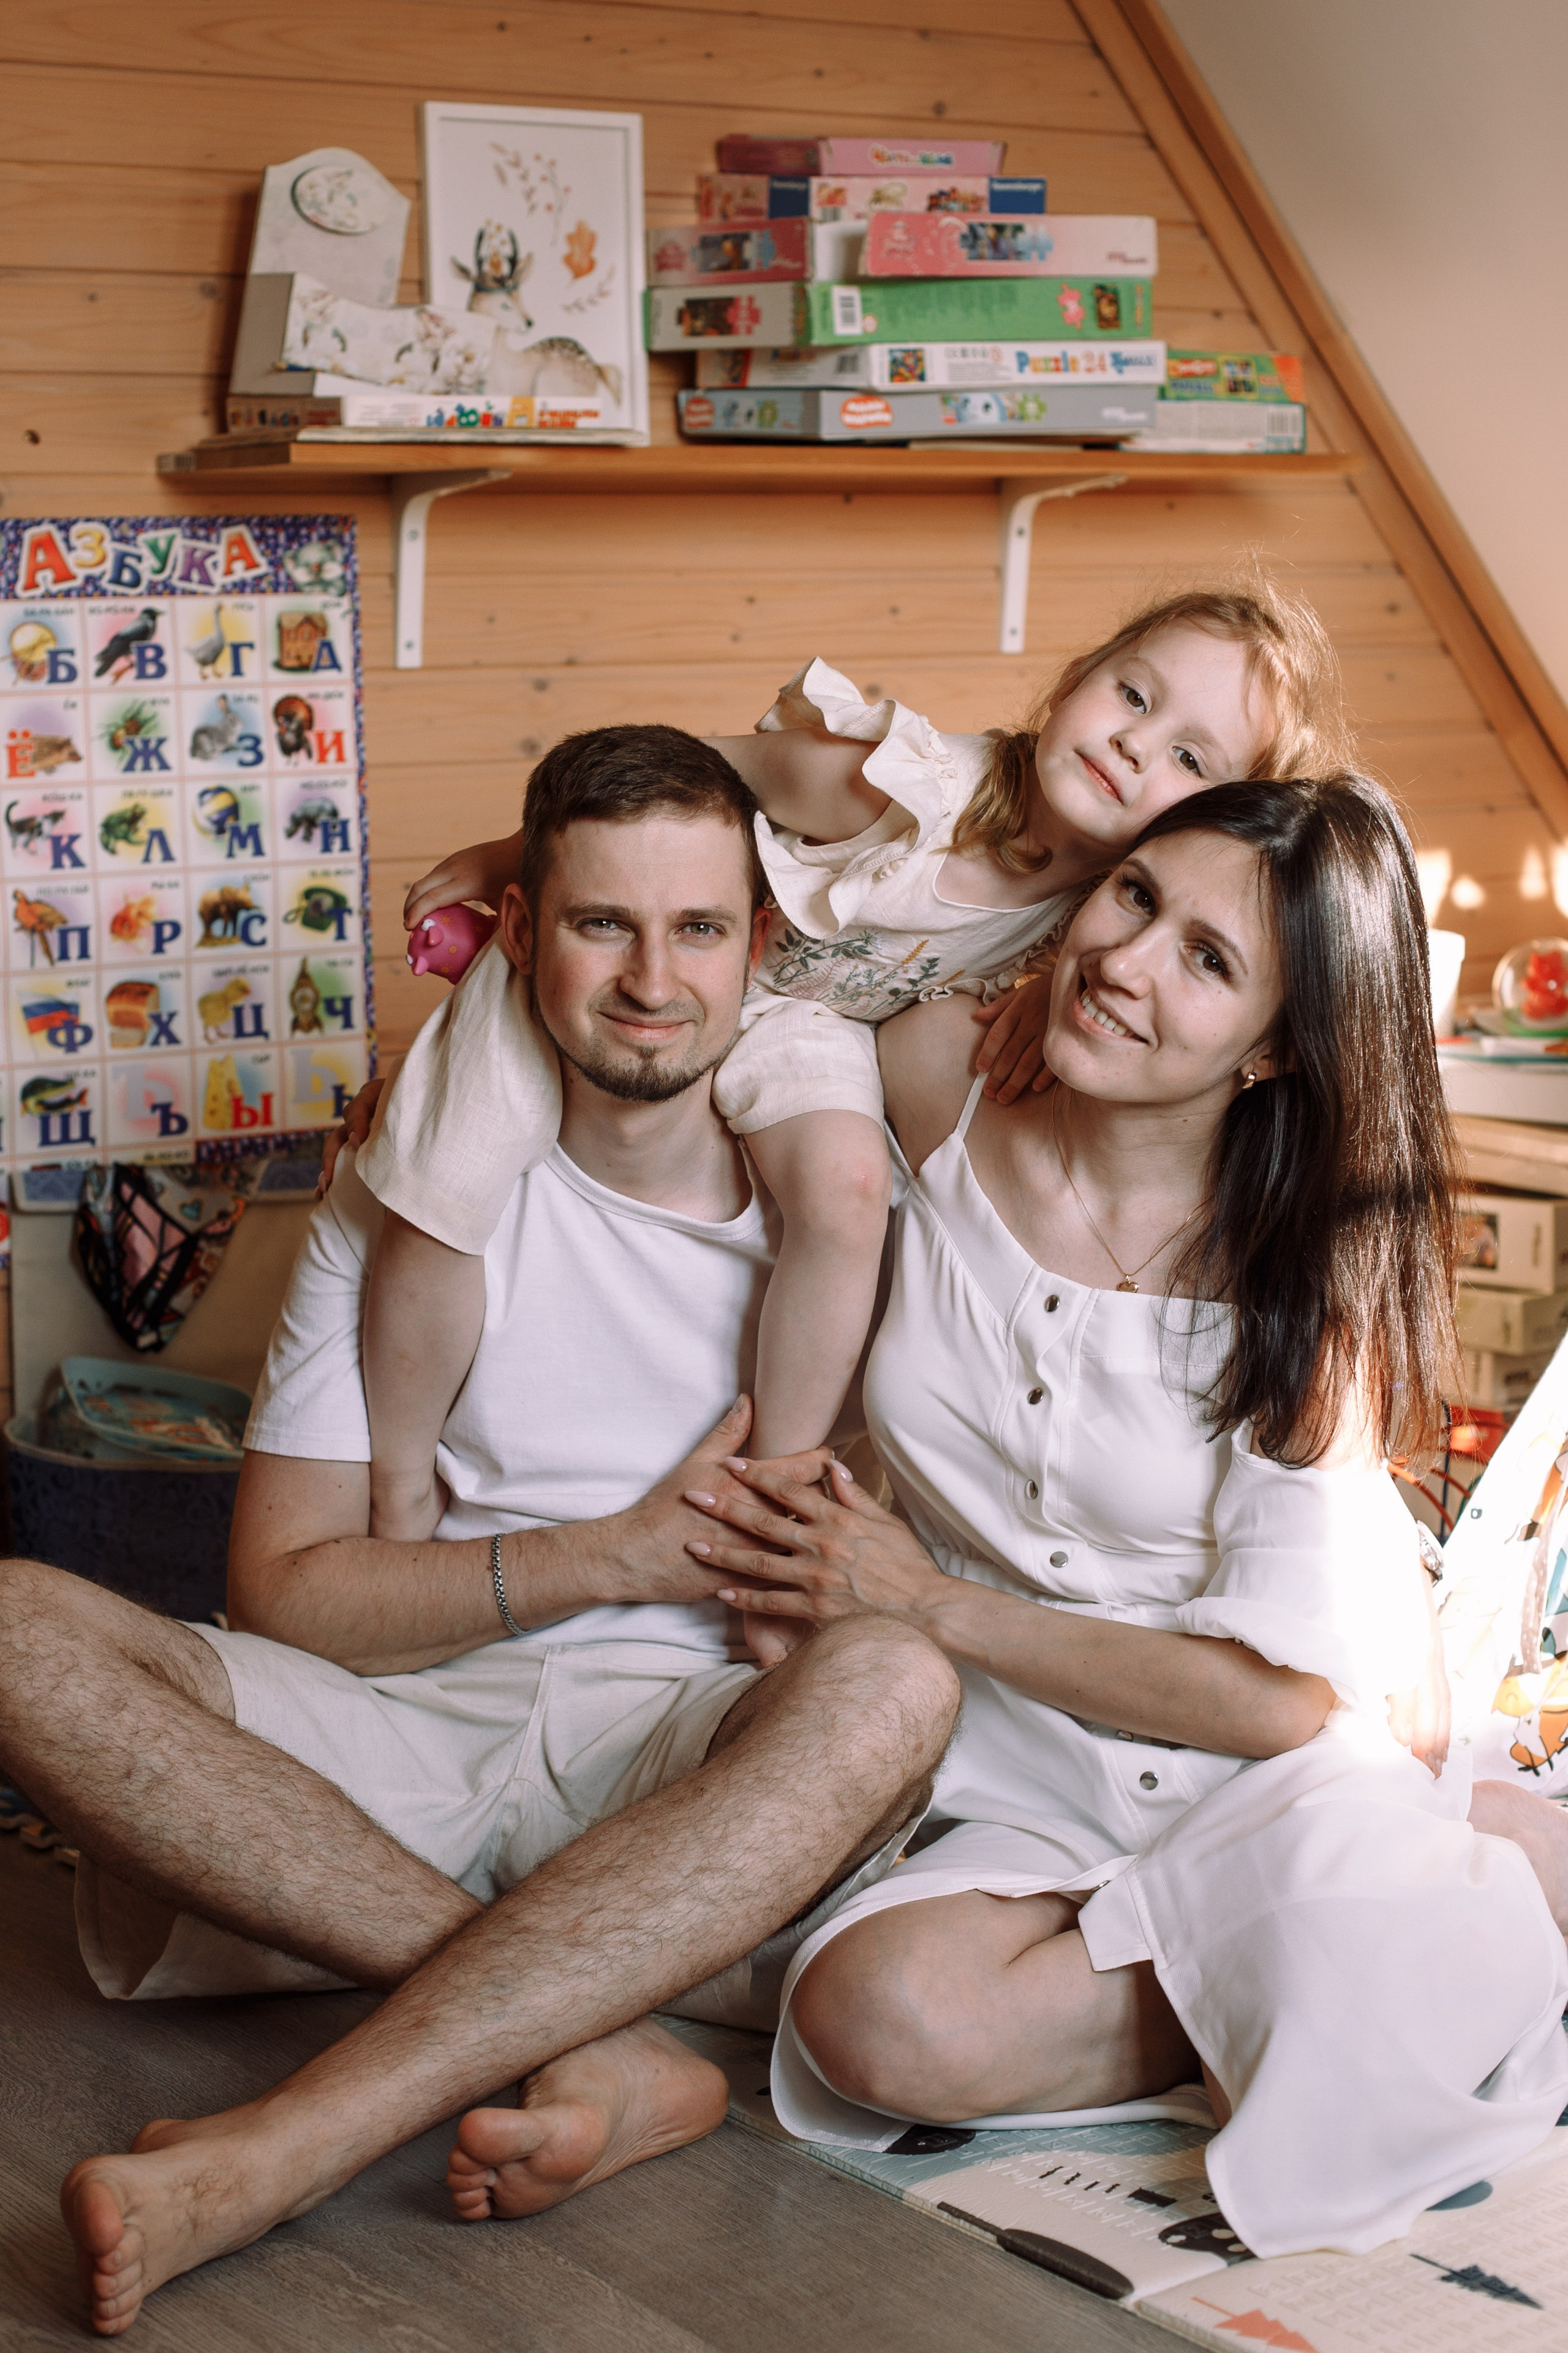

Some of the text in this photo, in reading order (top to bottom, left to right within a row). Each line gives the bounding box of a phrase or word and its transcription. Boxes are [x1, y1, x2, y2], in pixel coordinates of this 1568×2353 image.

[22, 527, 262, 592] АЗБУКА
[47, 639, 343, 683] Б В Г Д
[6, 731, 346, 778] Ё Ж З И
[50, 818, 352, 870] К Л М Н
[57, 908, 353, 961] П Р С Т
[48, 996, 353, 1054] Ф Х Ц Ч
[38, 1109, 96, 1147] Щ
[151, 1103, 189, 1138] Ъ
[232, 1093, 273, 1130] Ы
